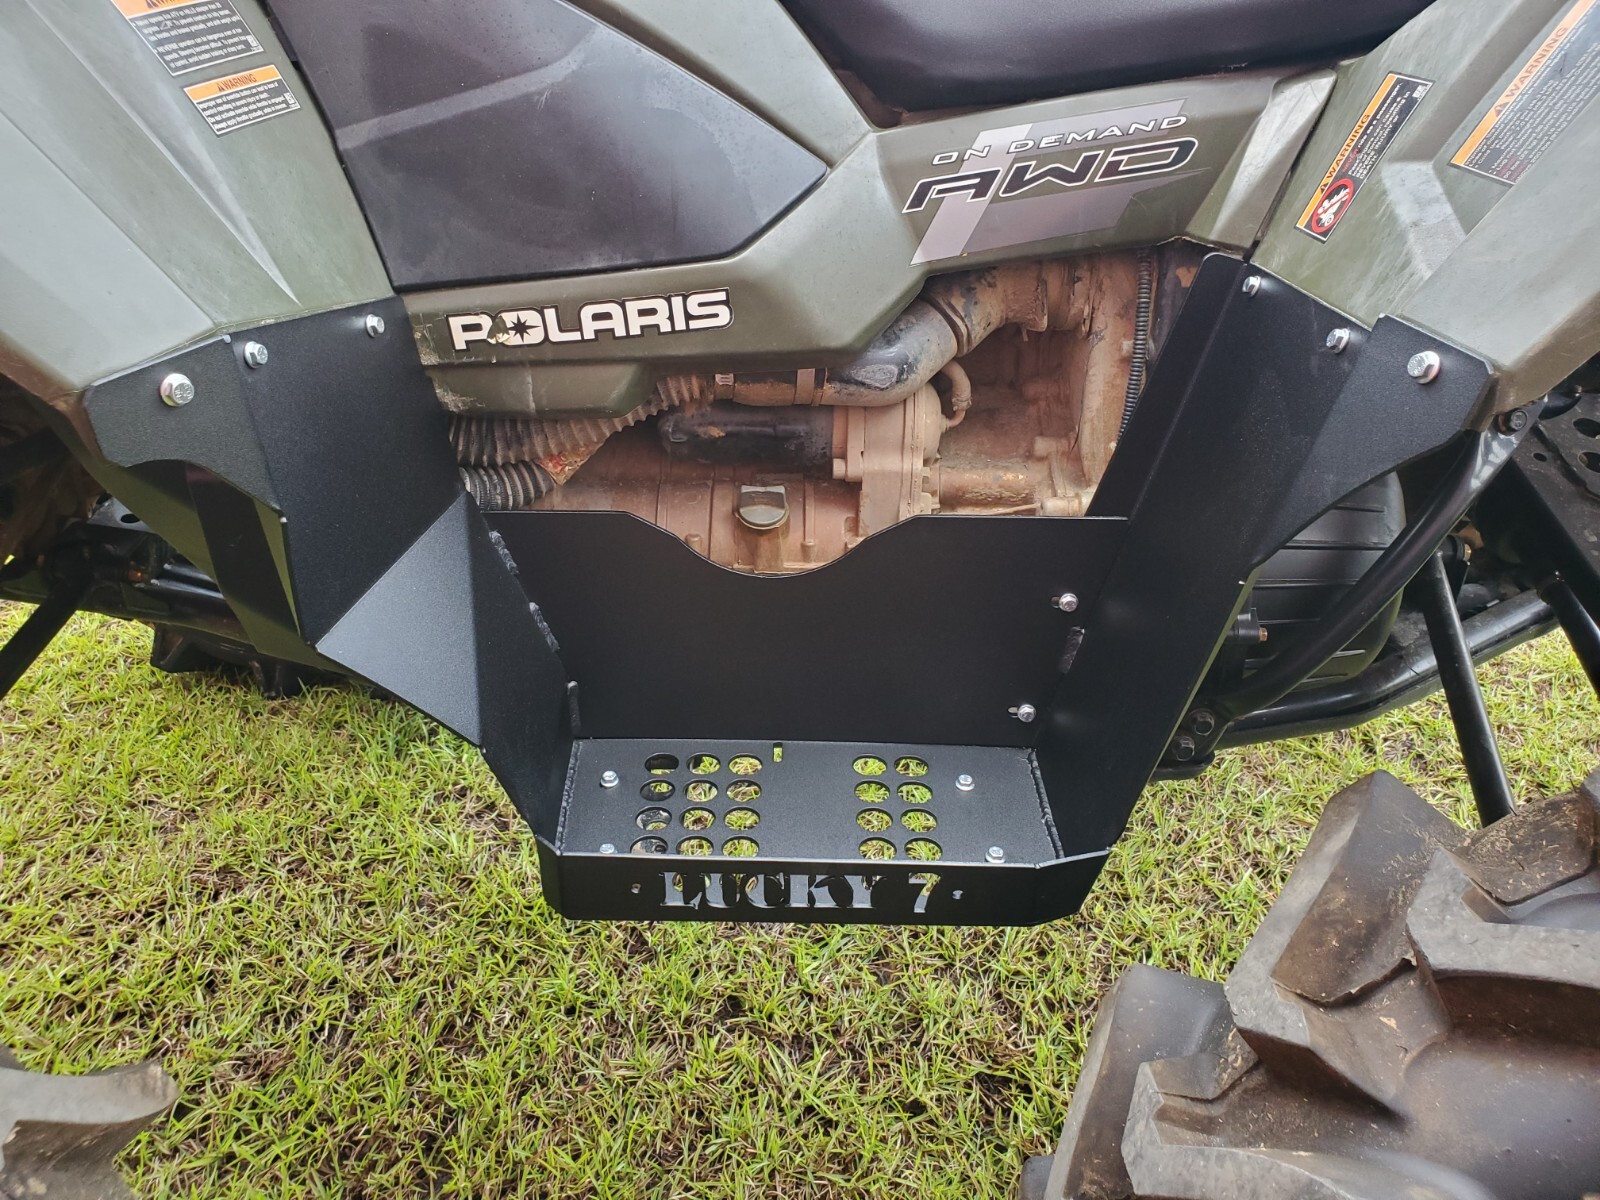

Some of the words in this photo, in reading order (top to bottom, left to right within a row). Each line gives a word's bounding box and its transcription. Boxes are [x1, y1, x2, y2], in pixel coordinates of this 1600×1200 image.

[220, 73, 258, 90] WARNING
[1505, 25, 1569, 97] WARNING
[931, 145, 991, 166] ON
[1007, 115, 1187, 154] DEMAND
[1326, 113, 1370, 178] WARNING
[901, 136, 1199, 214] AWD
[446, 288, 735, 351] POLARIS
[659, 870, 887, 910] LUCKY
[908, 872, 942, 913] 7
